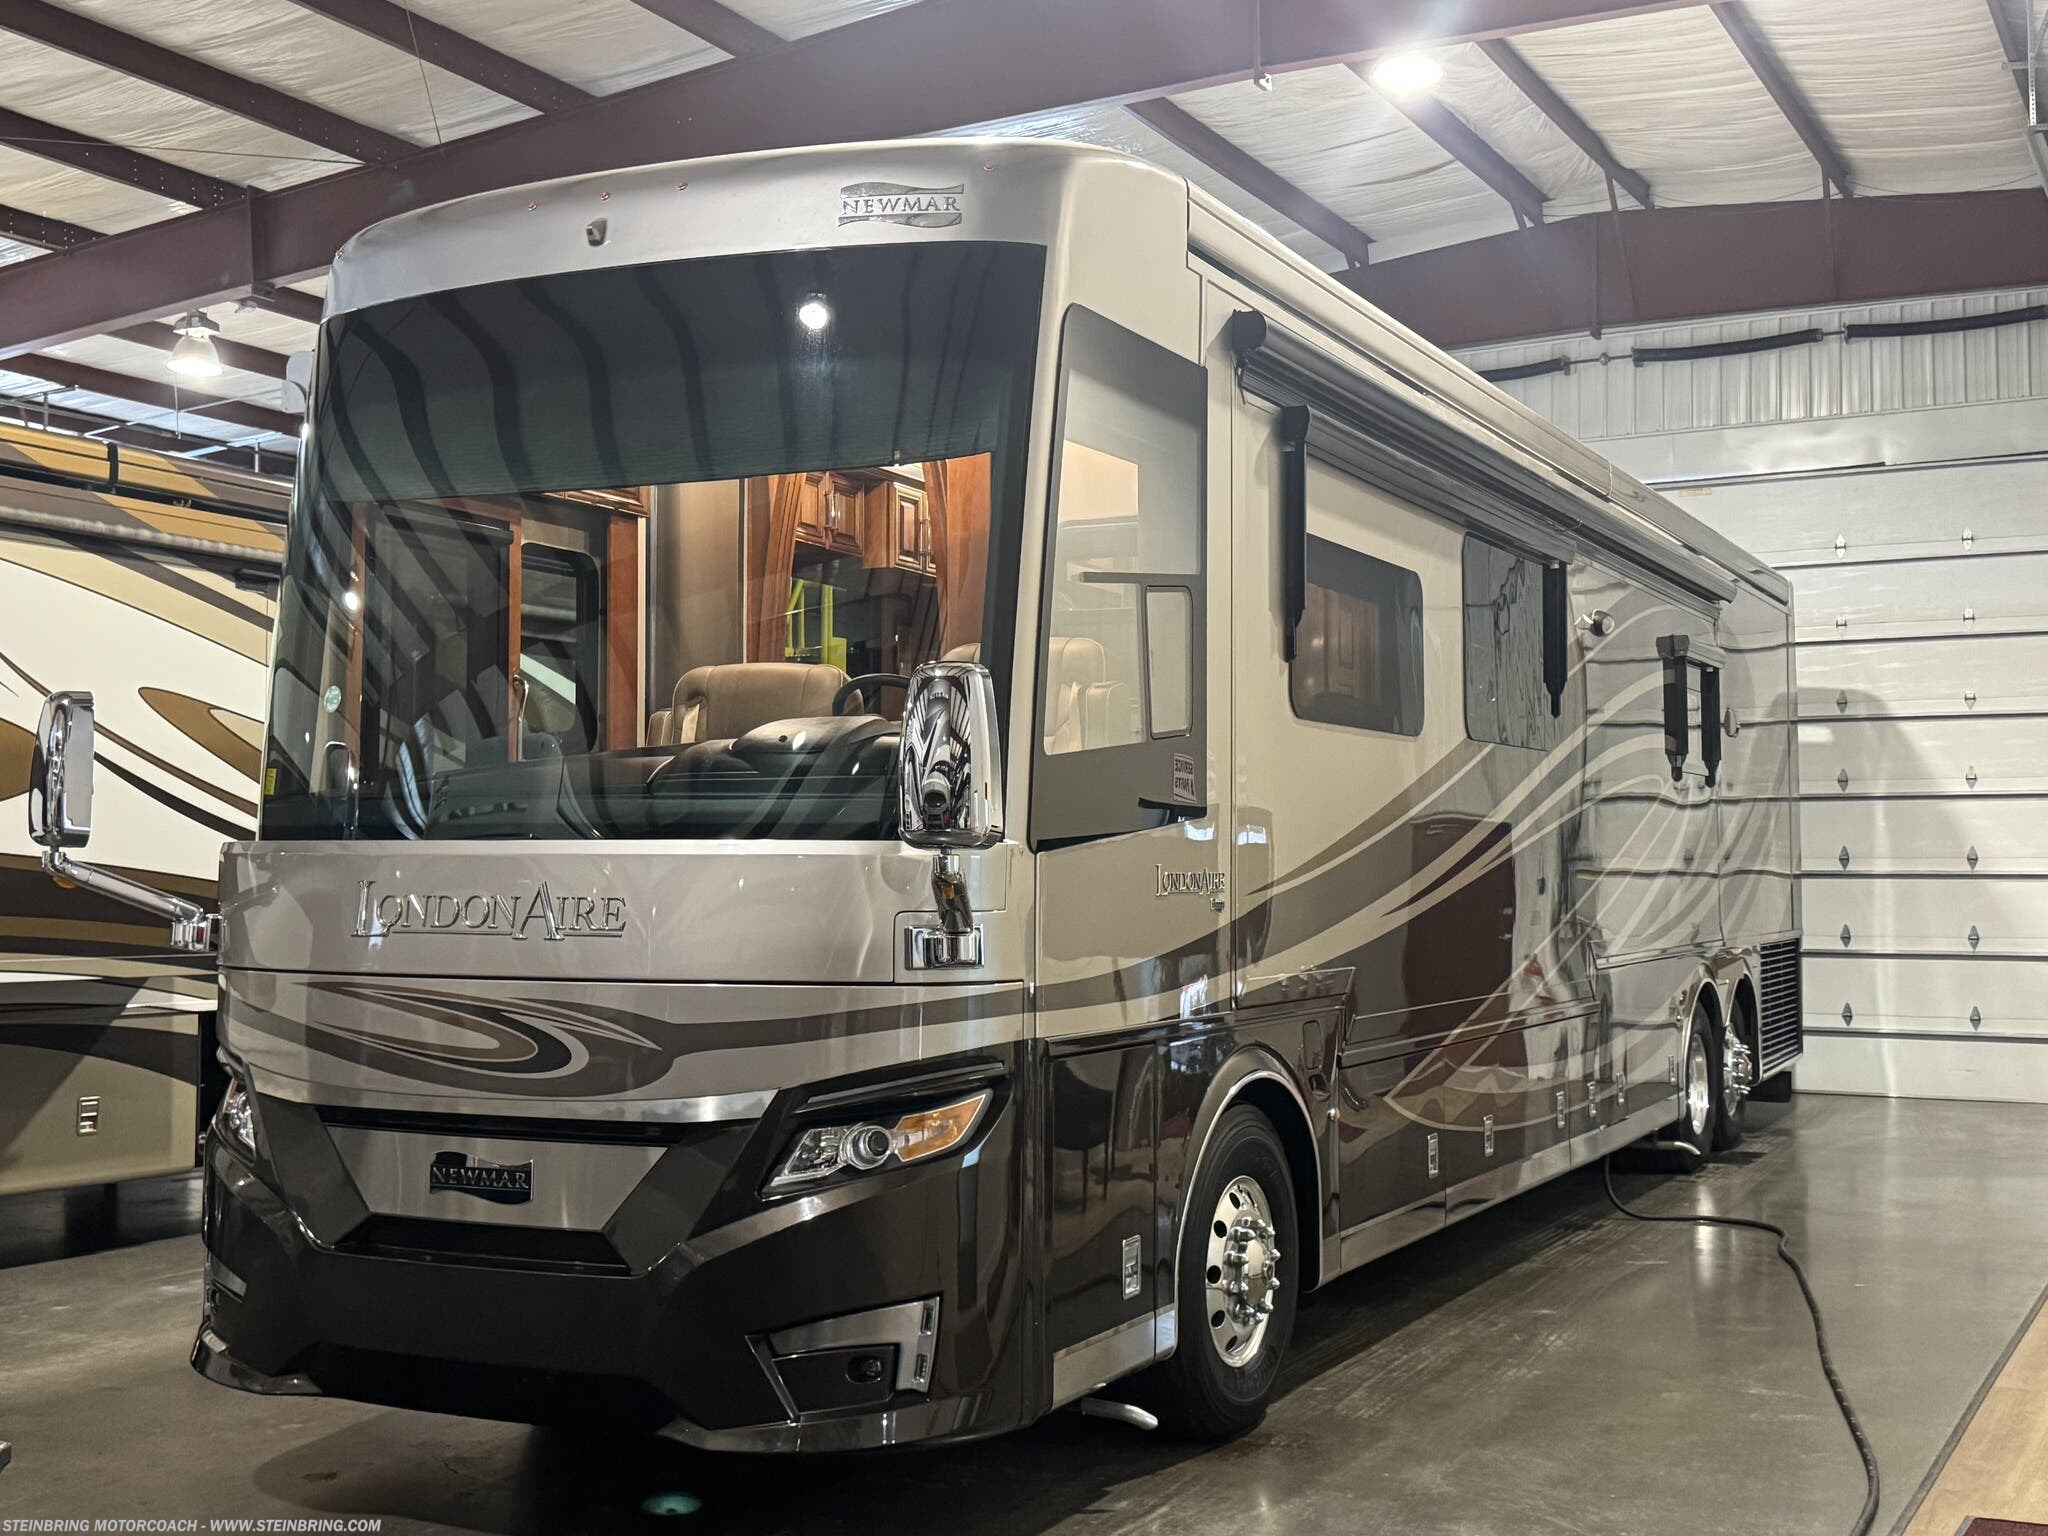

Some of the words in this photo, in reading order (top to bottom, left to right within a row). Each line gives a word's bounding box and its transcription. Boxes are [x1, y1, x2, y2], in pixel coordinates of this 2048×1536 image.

[842, 196, 961, 215] NEWMAR
[351, 880, 627, 941] LONDONAIRE
[431, 1166, 530, 1190] NEWMAR
